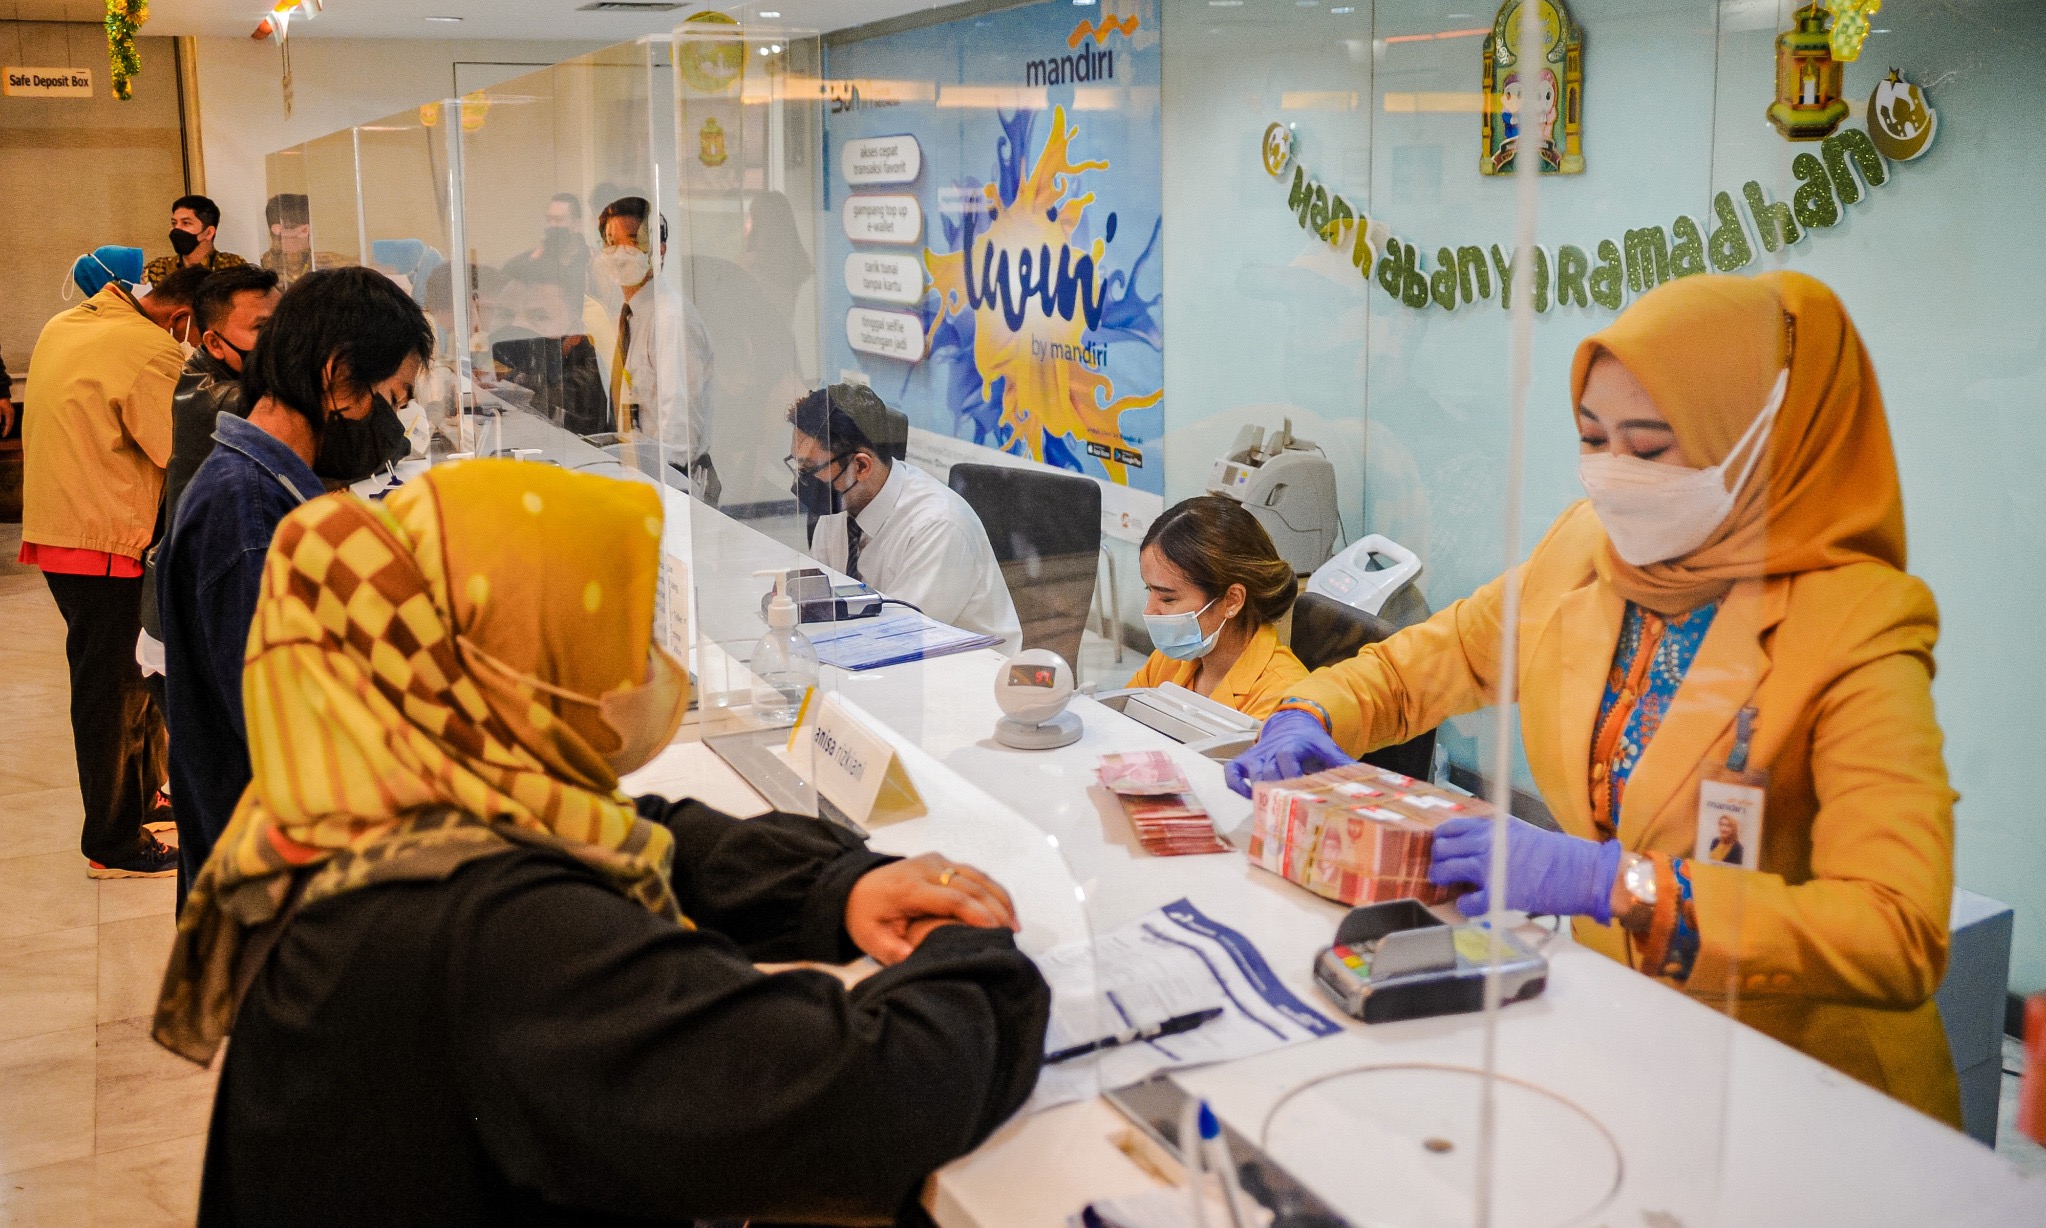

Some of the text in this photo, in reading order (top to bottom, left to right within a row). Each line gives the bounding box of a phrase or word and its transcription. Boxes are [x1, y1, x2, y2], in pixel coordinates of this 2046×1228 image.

[1026, 42, 1114, 88] mandiri
[9, 74, 89, 89] Safe Deposit Box
[1031, 333, 1108, 367] by mandiri
[815, 727, 836, 756] anisa
